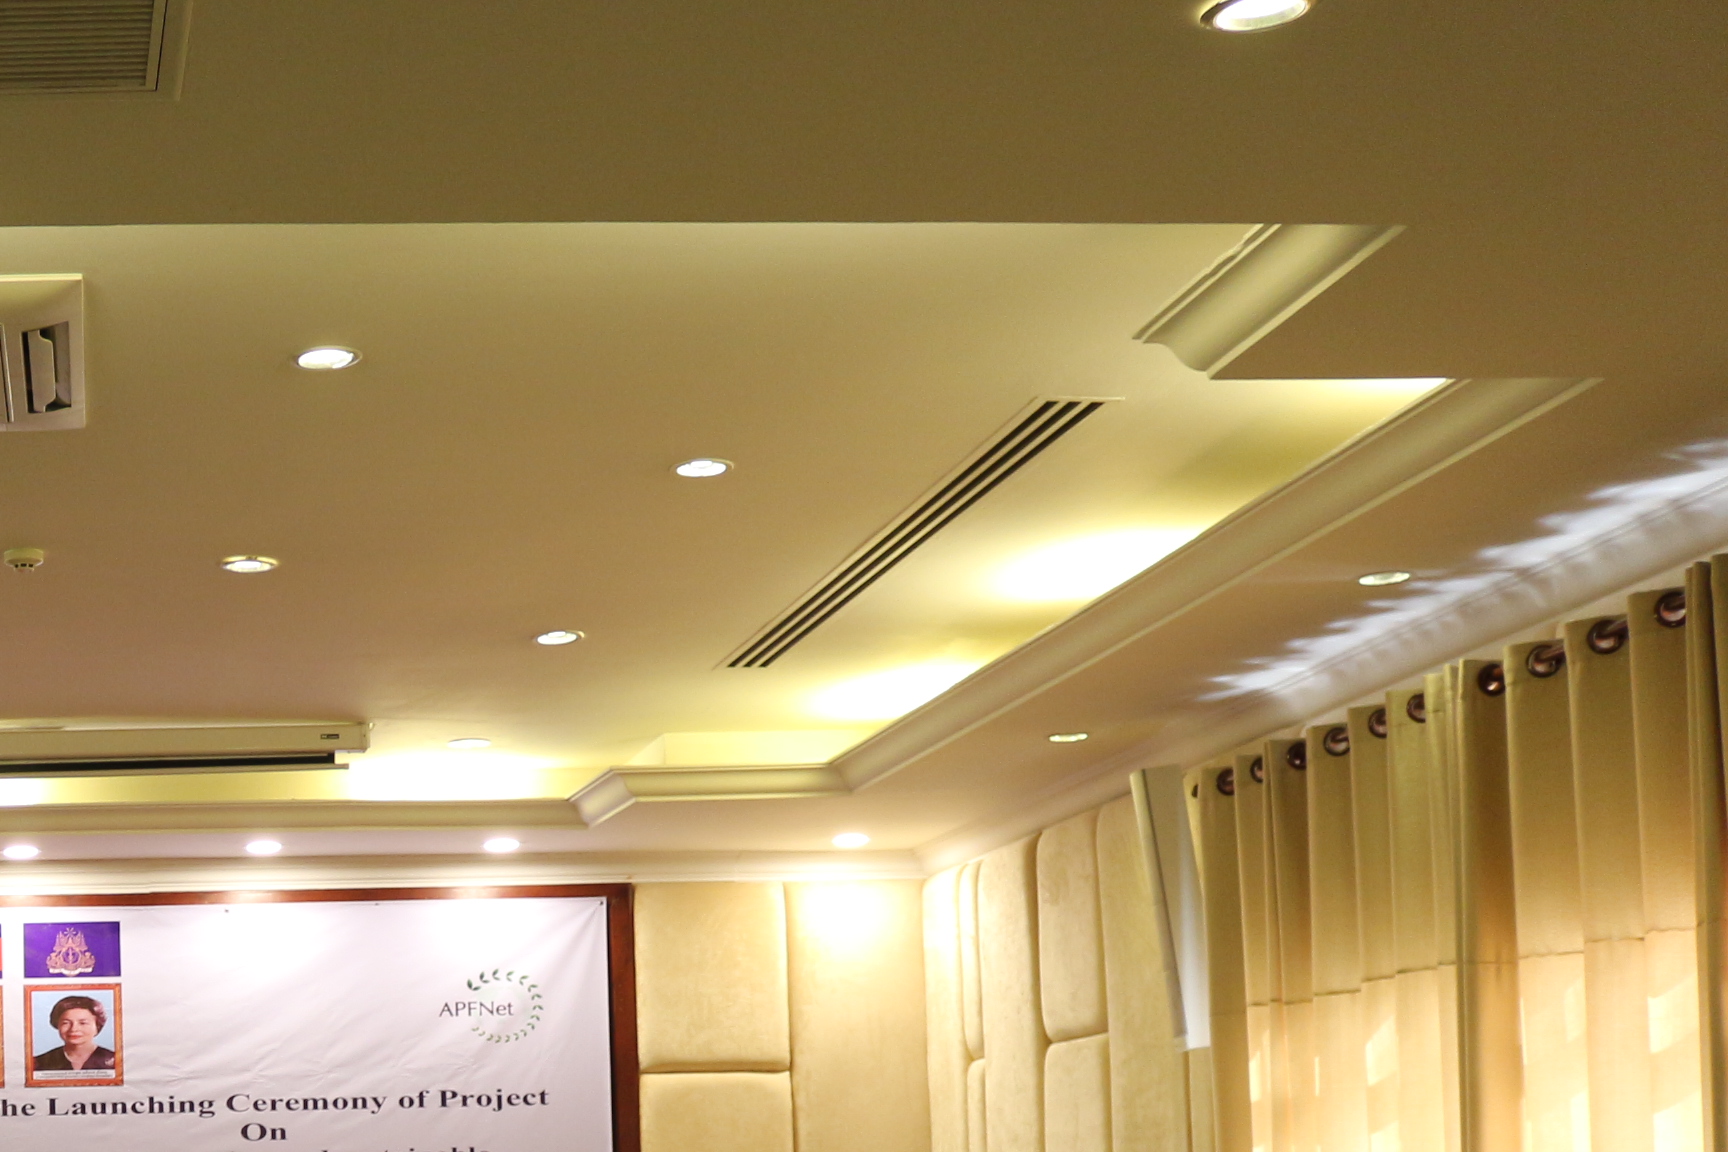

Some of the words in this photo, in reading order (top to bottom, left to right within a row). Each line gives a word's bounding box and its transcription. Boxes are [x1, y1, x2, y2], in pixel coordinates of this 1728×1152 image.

[438, 1000, 515, 1017] APFNet
[46, 1095, 216, 1119] Launching
[225, 1093, 387, 1115] Ceremony
[398, 1090, 430, 1109] of
[438, 1087, 550, 1112] Project
[240, 1122, 288, 1142] On
